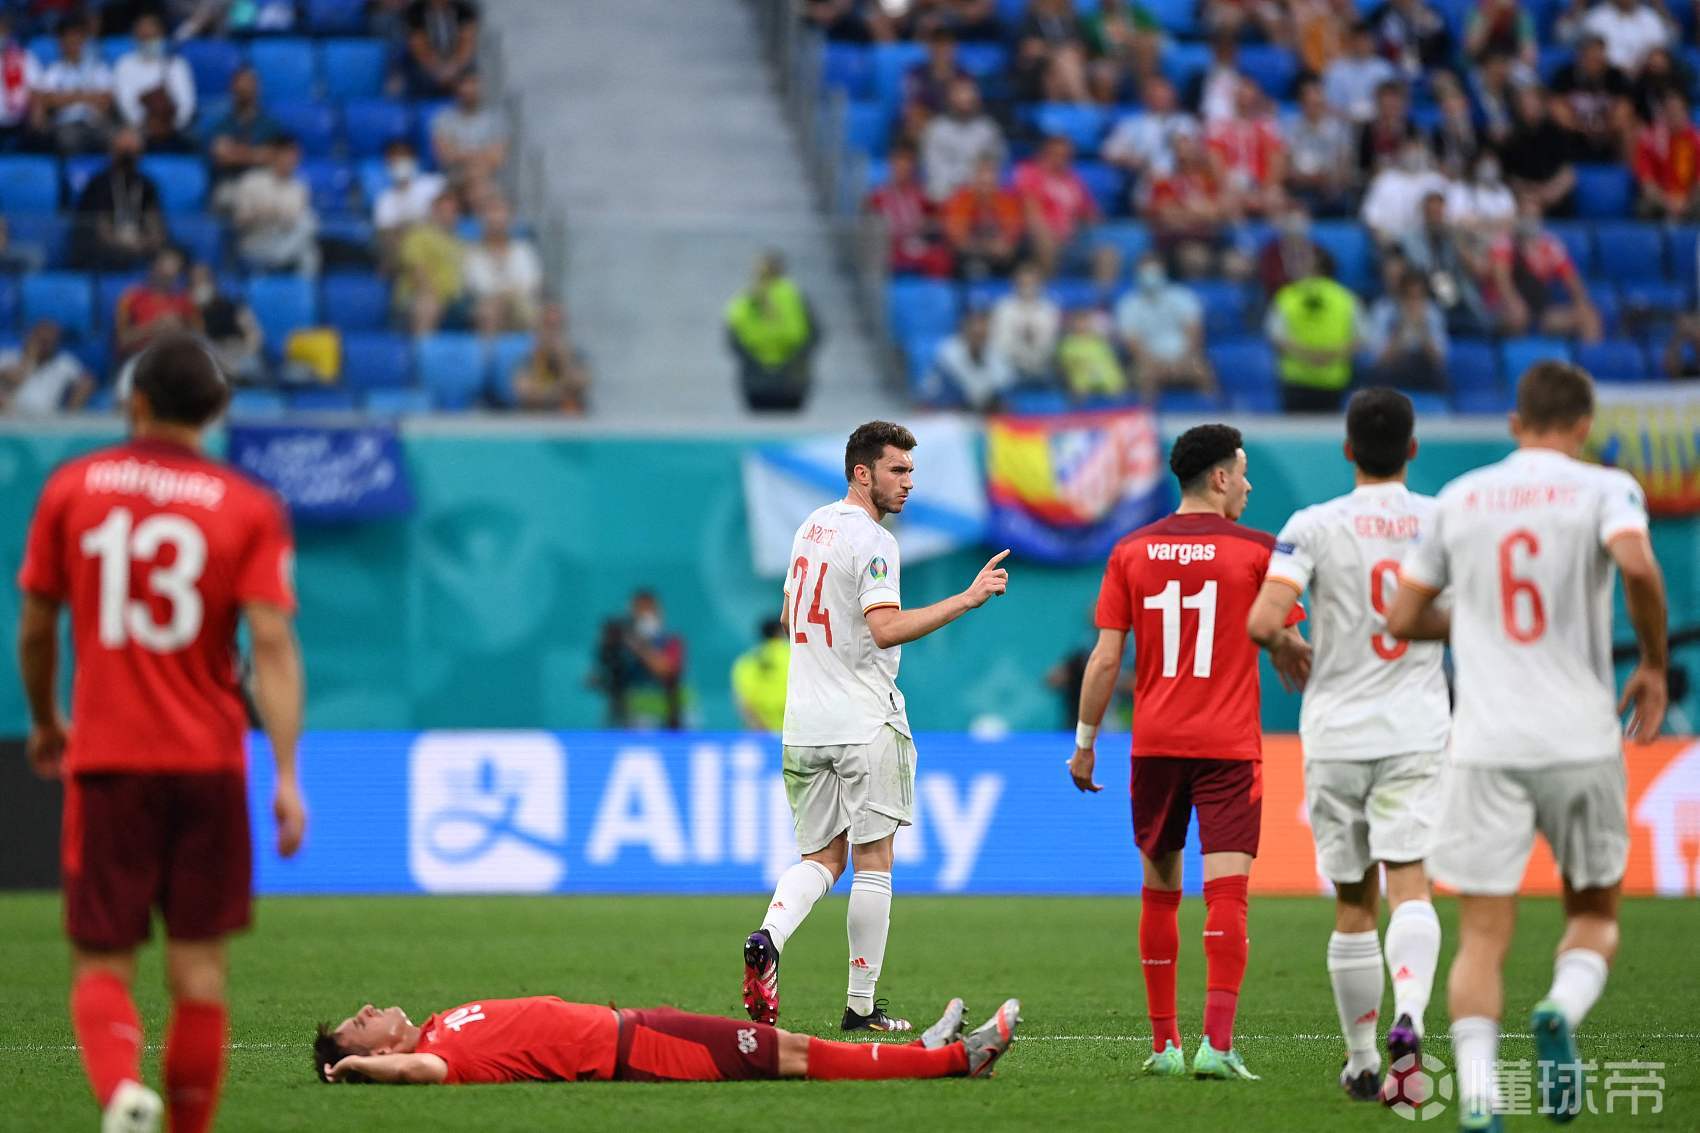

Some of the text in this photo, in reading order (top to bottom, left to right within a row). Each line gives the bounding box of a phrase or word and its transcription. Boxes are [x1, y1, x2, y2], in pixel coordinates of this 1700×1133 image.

[80, 506, 208, 654] 13
[792, 555, 833, 648] 24
[1147, 543, 1216, 565] vargas
[1497, 528, 1548, 645] 6
[1143, 579, 1218, 679] 11
[1369, 559, 1408, 661] 9
